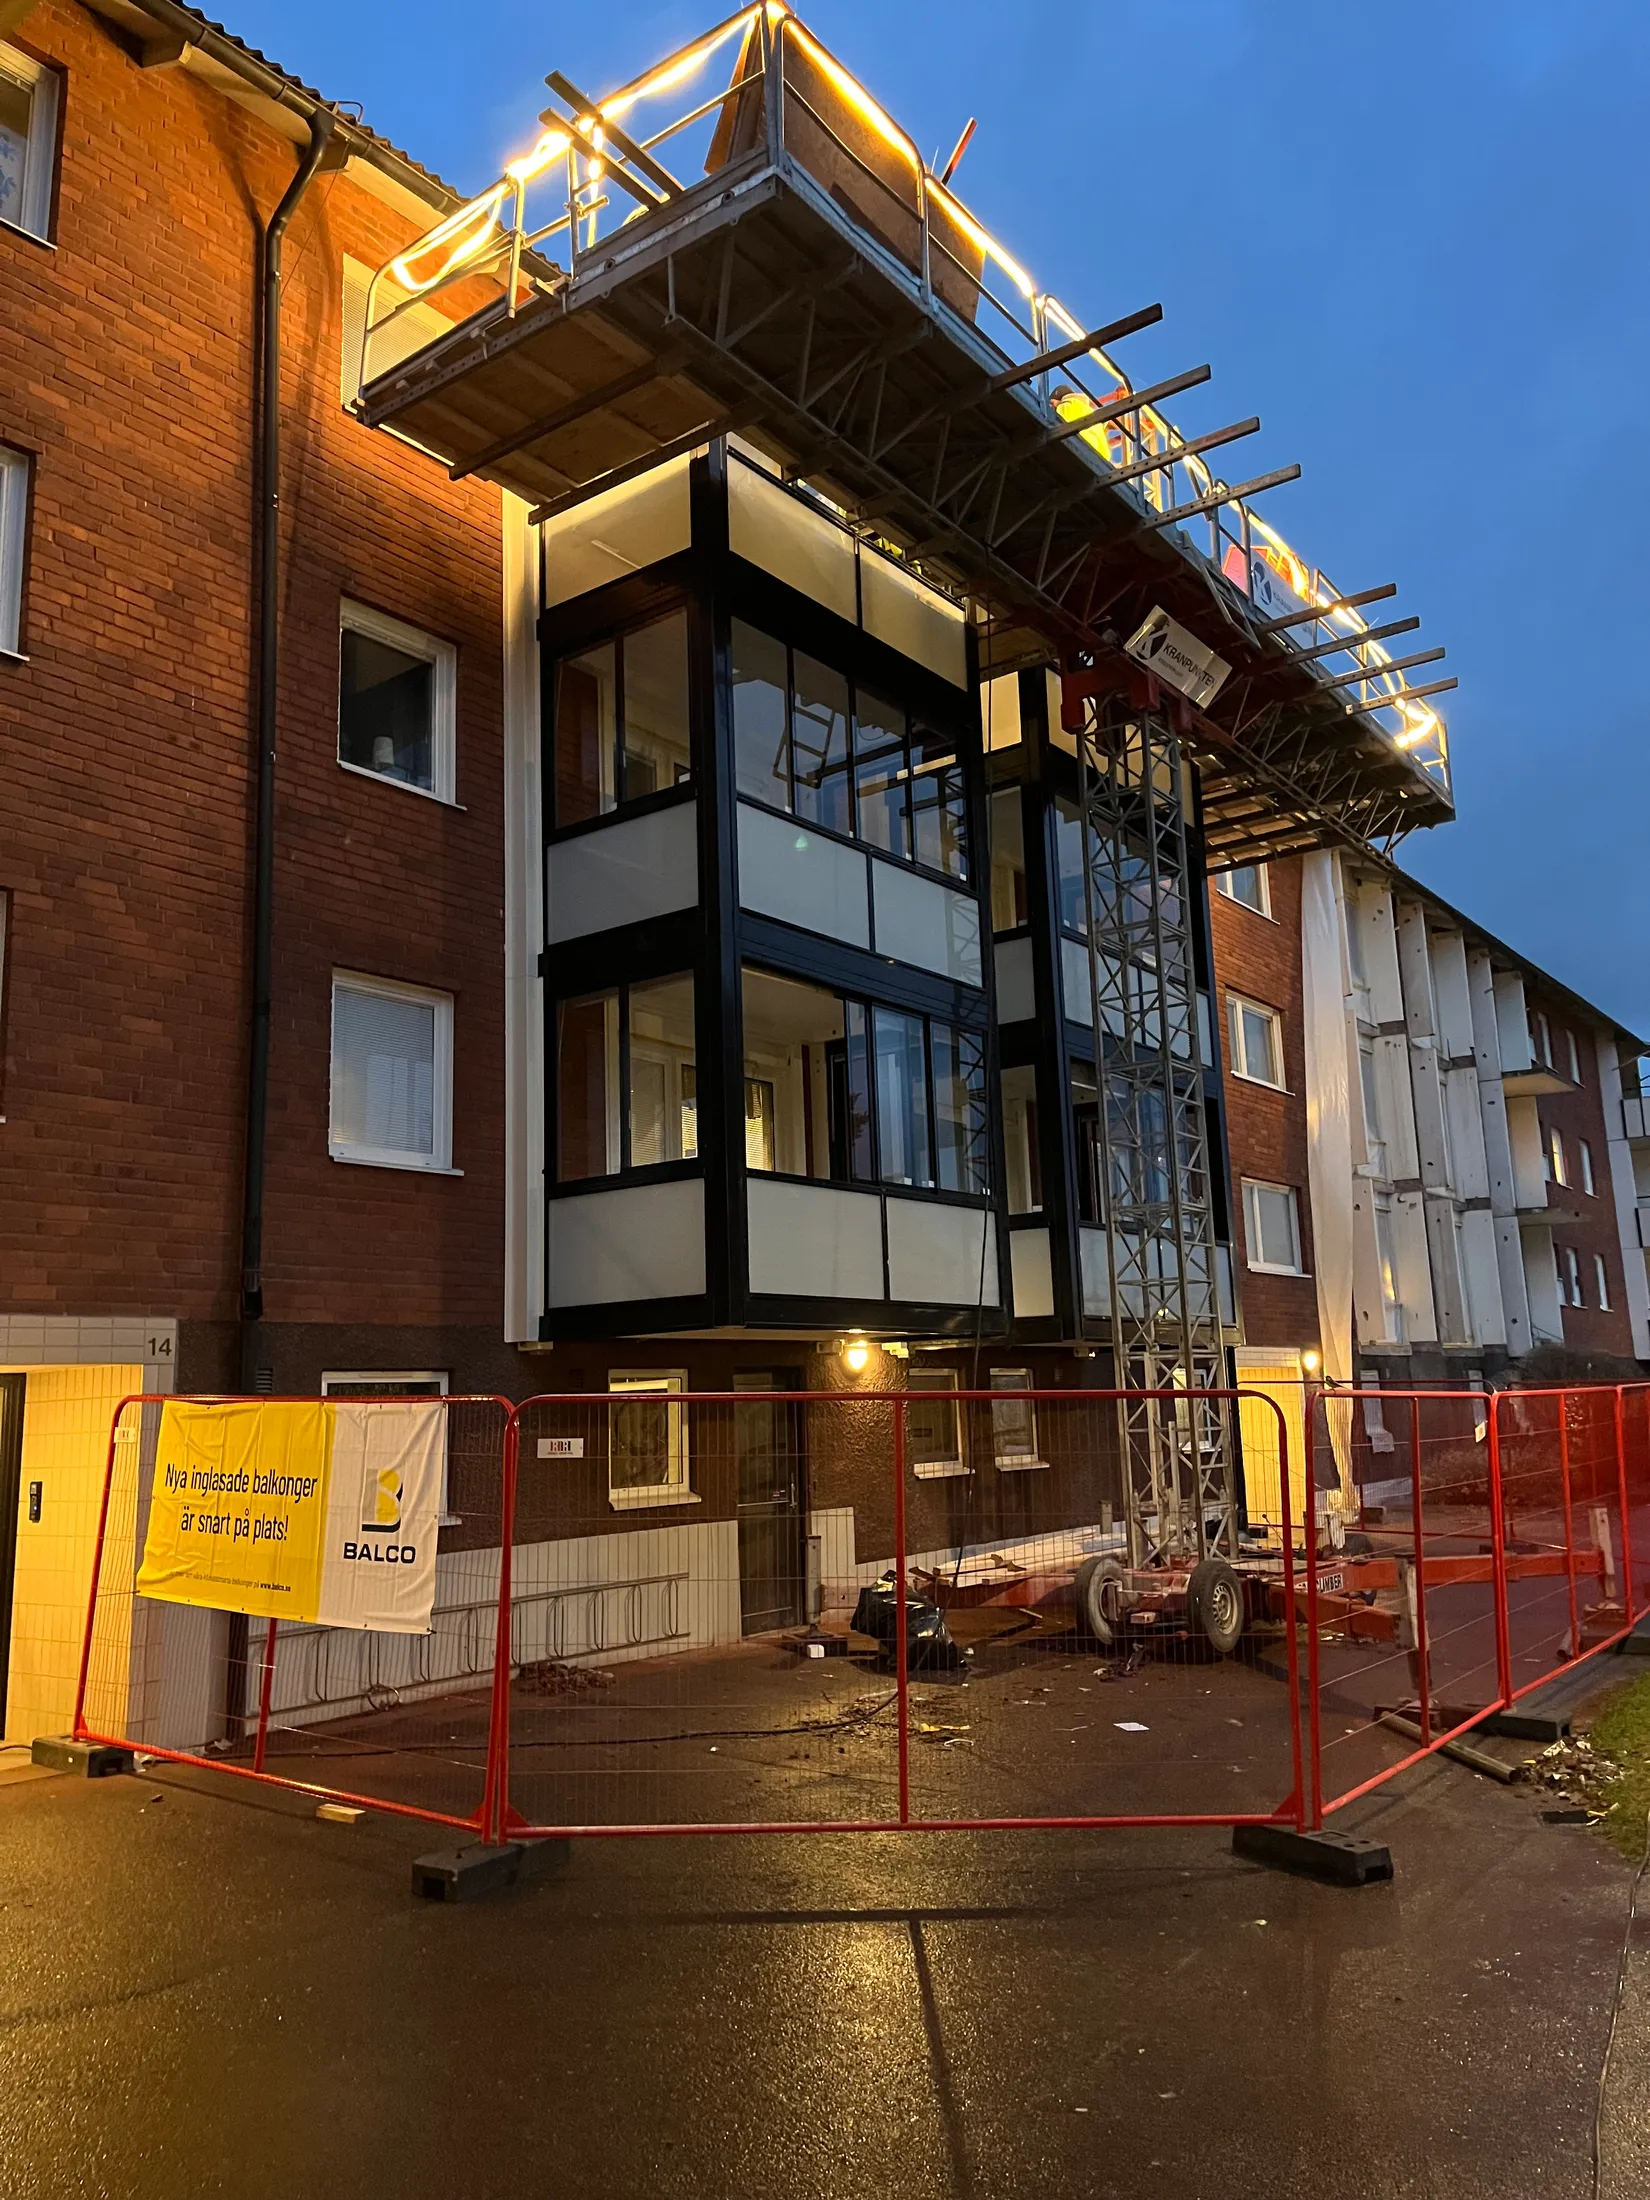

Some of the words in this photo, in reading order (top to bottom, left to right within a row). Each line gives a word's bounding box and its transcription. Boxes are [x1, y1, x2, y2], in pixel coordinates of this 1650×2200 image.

[148, 1337, 172, 1356] 14
[165, 1463, 188, 1494] Nya
[190, 1464, 250, 1497] inglasade
[252, 1468, 319, 1504] balkonger
[180, 1505, 195, 1531] är
[197, 1512, 231, 1536] snart
[233, 1508, 250, 1543] på
[252, 1513, 289, 1545] plats!
[343, 1542, 416, 1564] BALCO
